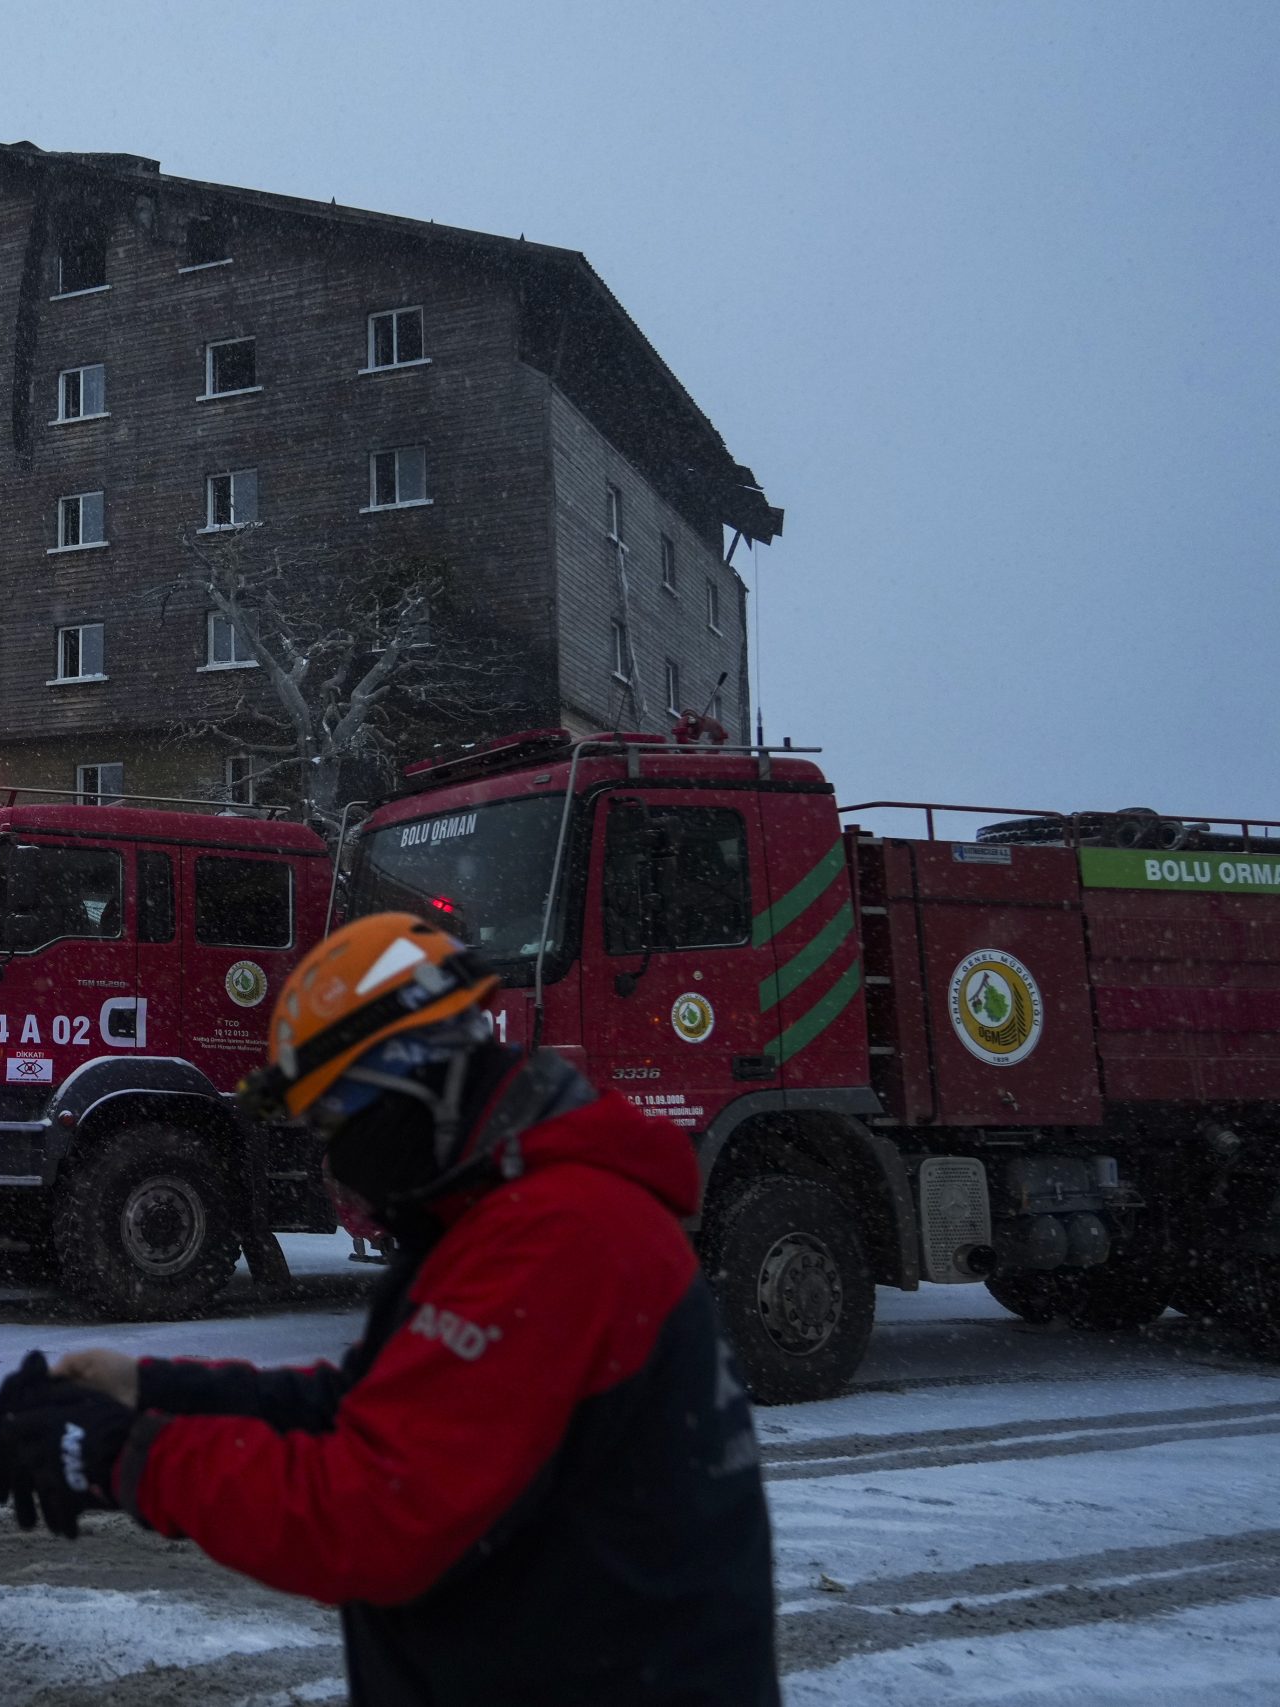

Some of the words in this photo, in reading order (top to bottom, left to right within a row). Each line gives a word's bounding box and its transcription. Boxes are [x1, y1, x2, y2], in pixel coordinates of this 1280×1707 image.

[400, 822, 430, 848] BOLU
[431, 813, 477, 841] ORMAN
[1144, 858, 1211, 883] BOLU
[952, 978, 962, 1025] ORMAN
[20, 1014, 42, 1044] A
[52, 1014, 91, 1046] 02
[978, 1026, 1001, 1046] OGM
[612, 1068, 662, 1080] 3336
